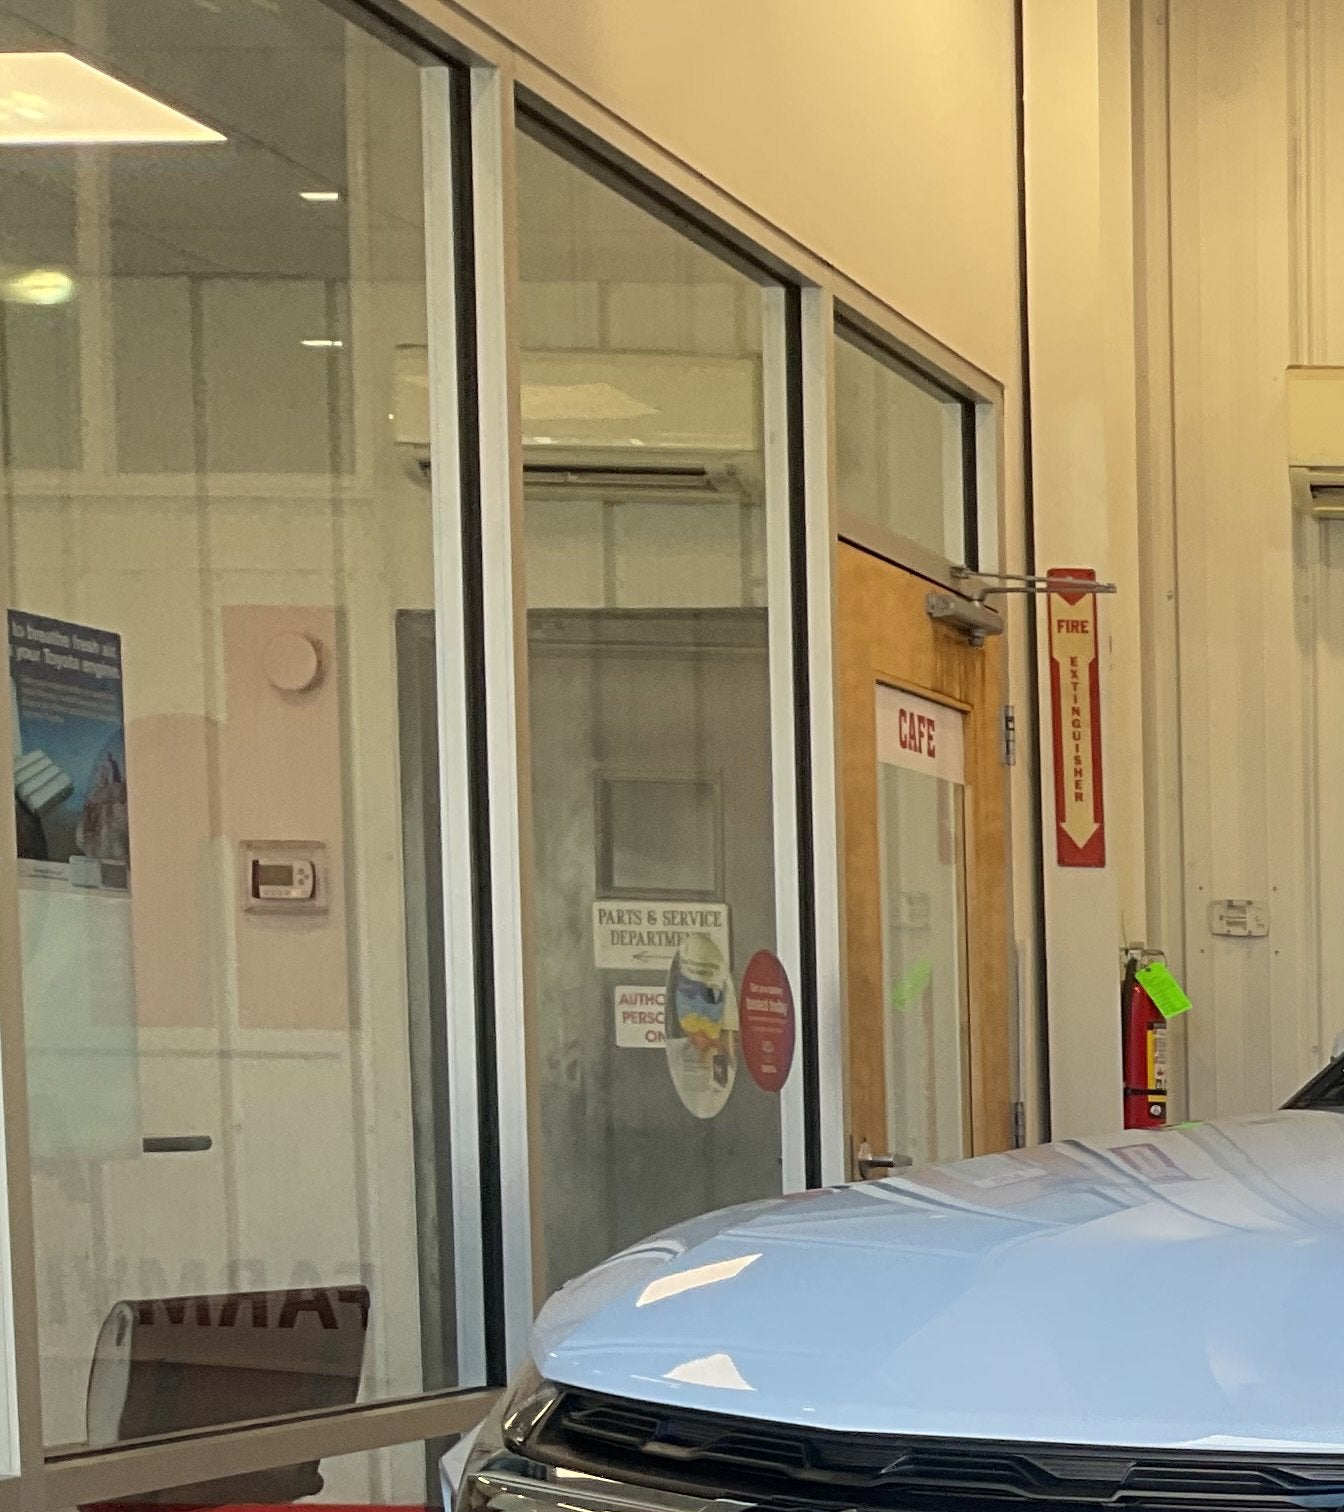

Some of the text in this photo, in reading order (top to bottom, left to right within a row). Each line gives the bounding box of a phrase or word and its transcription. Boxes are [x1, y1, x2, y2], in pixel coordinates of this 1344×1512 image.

[1056, 619, 1090, 634] FIRE
[899, 708, 936, 758] CAFE
[1070, 657, 1084, 802] EXTINGUISHER
[598, 908, 722, 928] PARTS & SERVICE
[610, 929, 711, 948] DEPARTME
